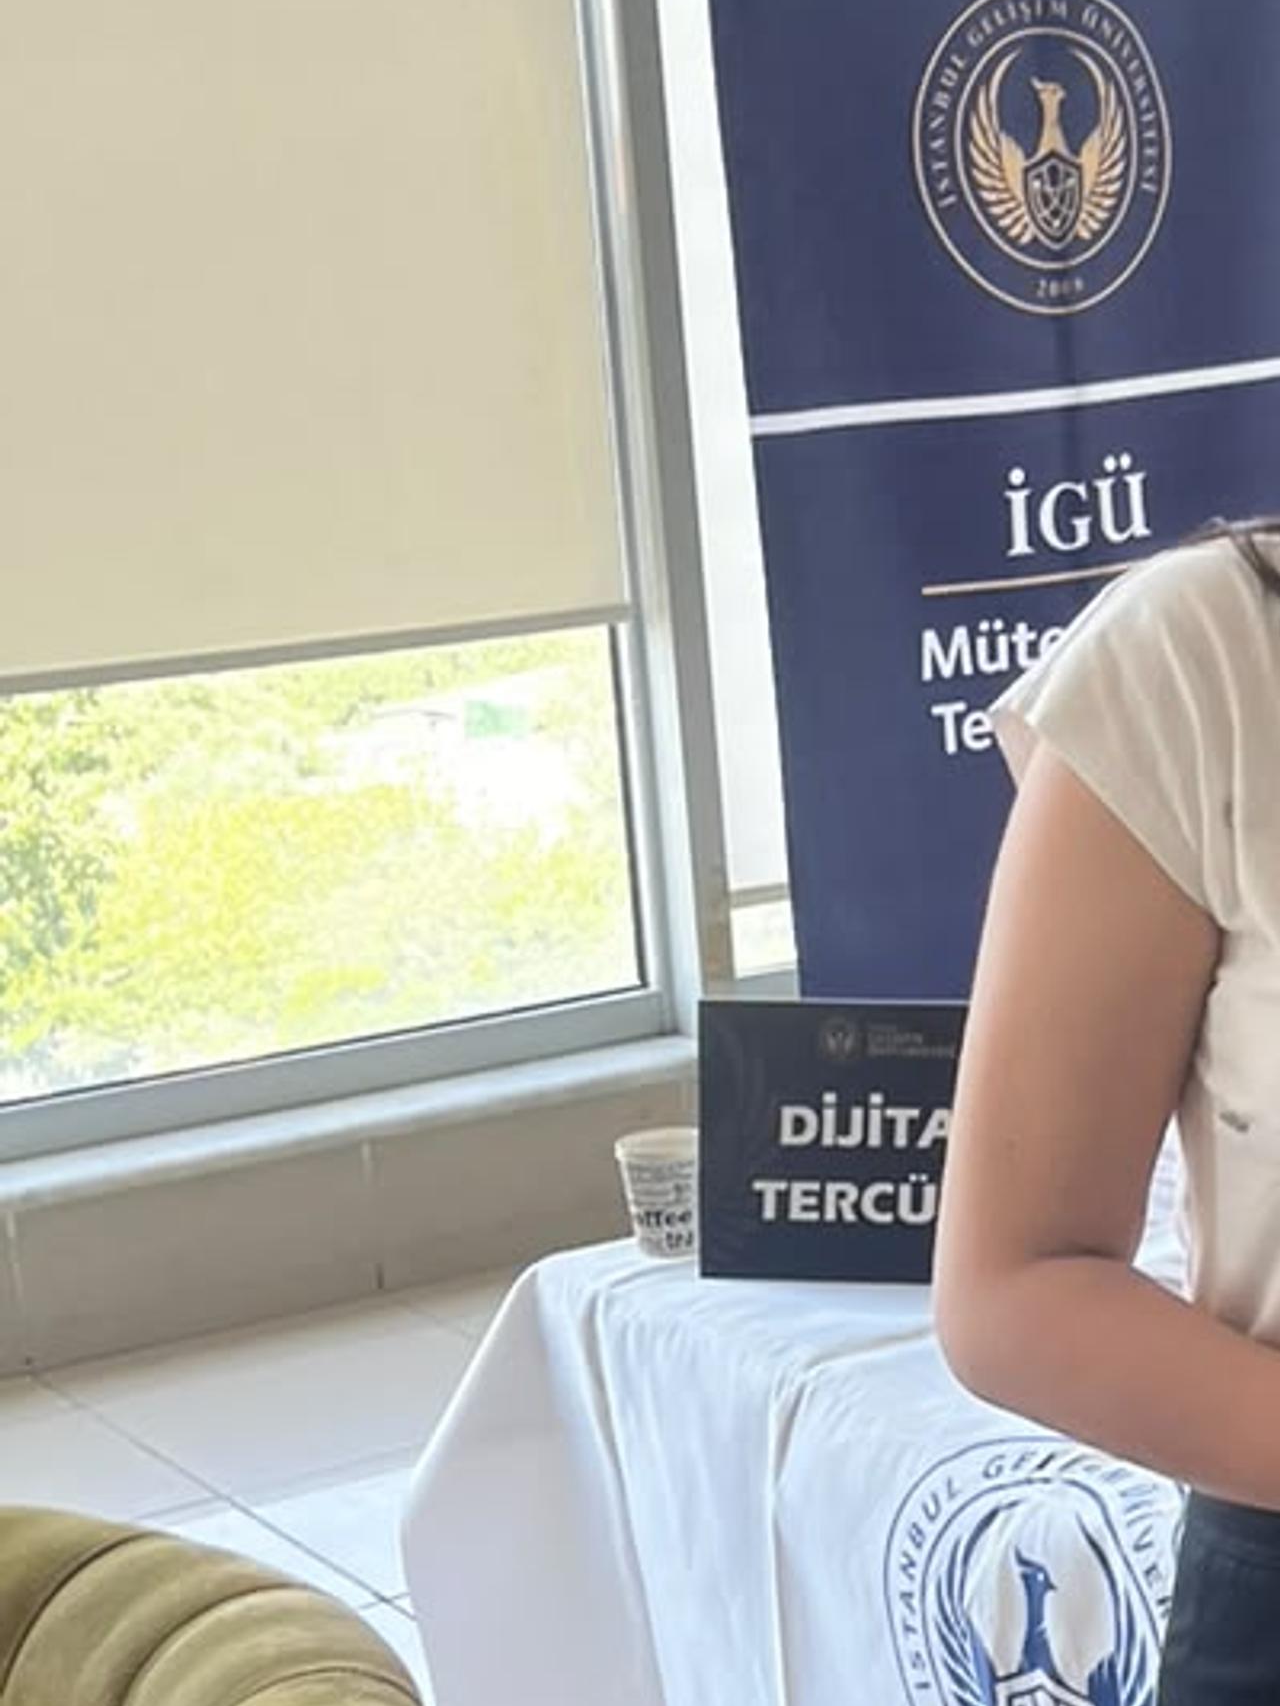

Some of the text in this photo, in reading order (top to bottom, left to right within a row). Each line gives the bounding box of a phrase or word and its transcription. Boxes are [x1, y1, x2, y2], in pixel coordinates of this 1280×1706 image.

[1004, 453, 1152, 557] İGÜ
[930, 701, 994, 755] Te
[752, 1173, 938, 1224] TERCÜ
